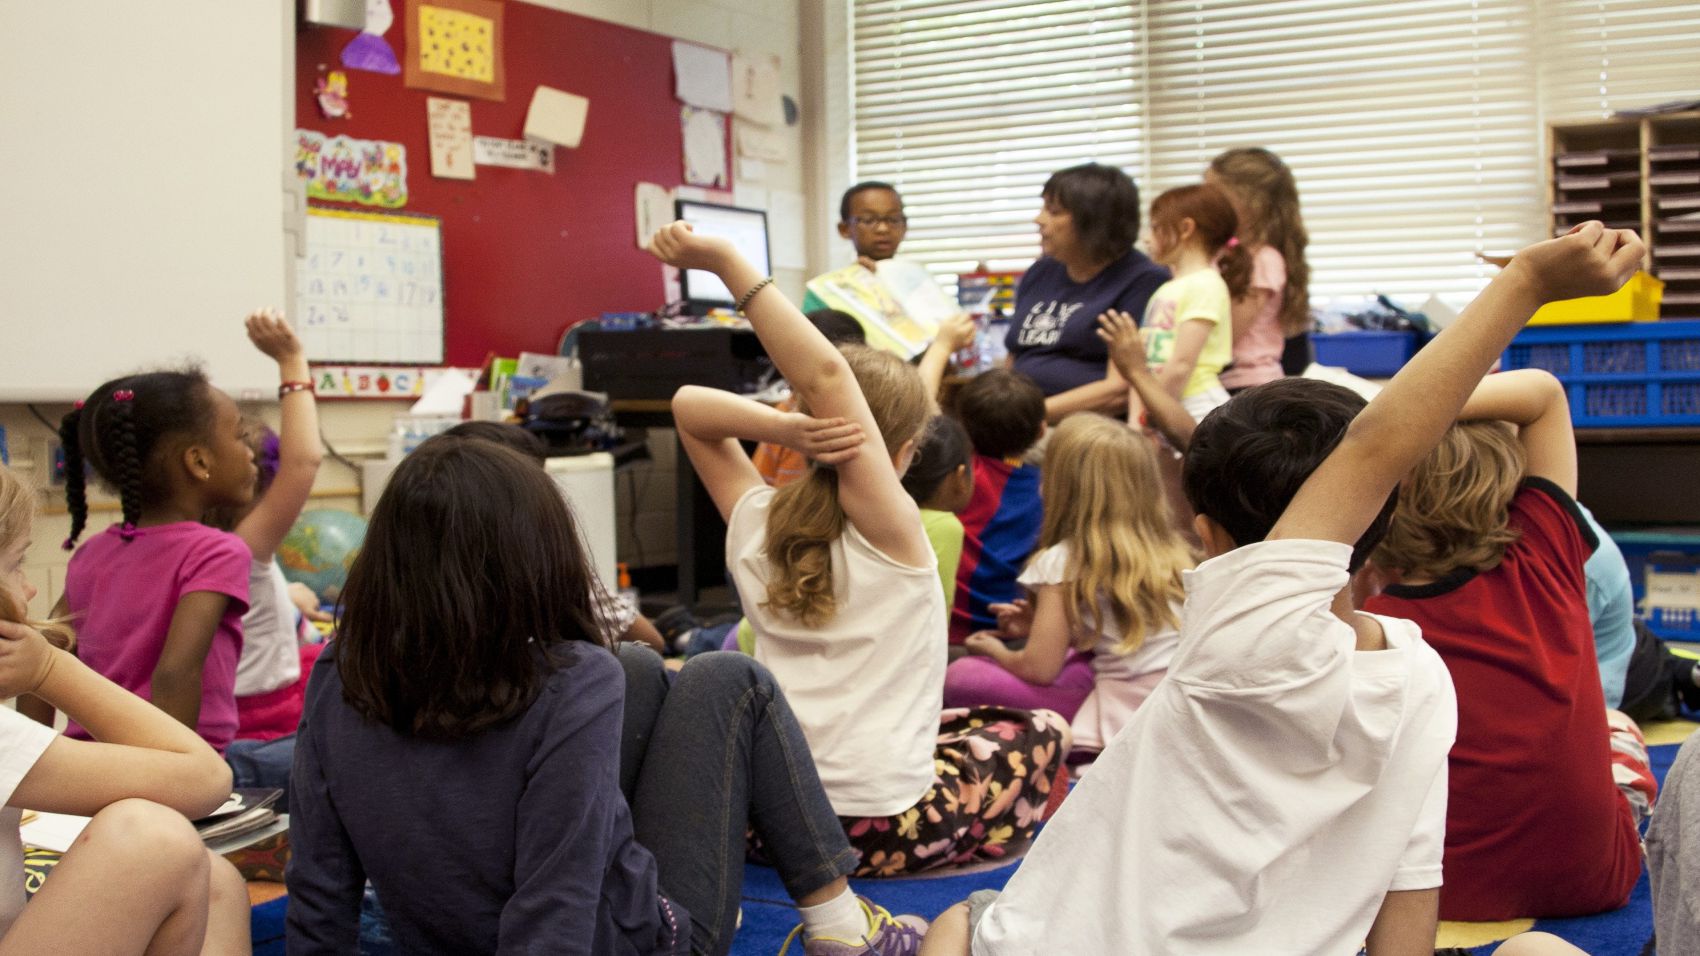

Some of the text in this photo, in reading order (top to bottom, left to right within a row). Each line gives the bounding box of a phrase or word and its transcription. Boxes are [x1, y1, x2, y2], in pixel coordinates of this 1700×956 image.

[320, 372, 409, 391] A B C
